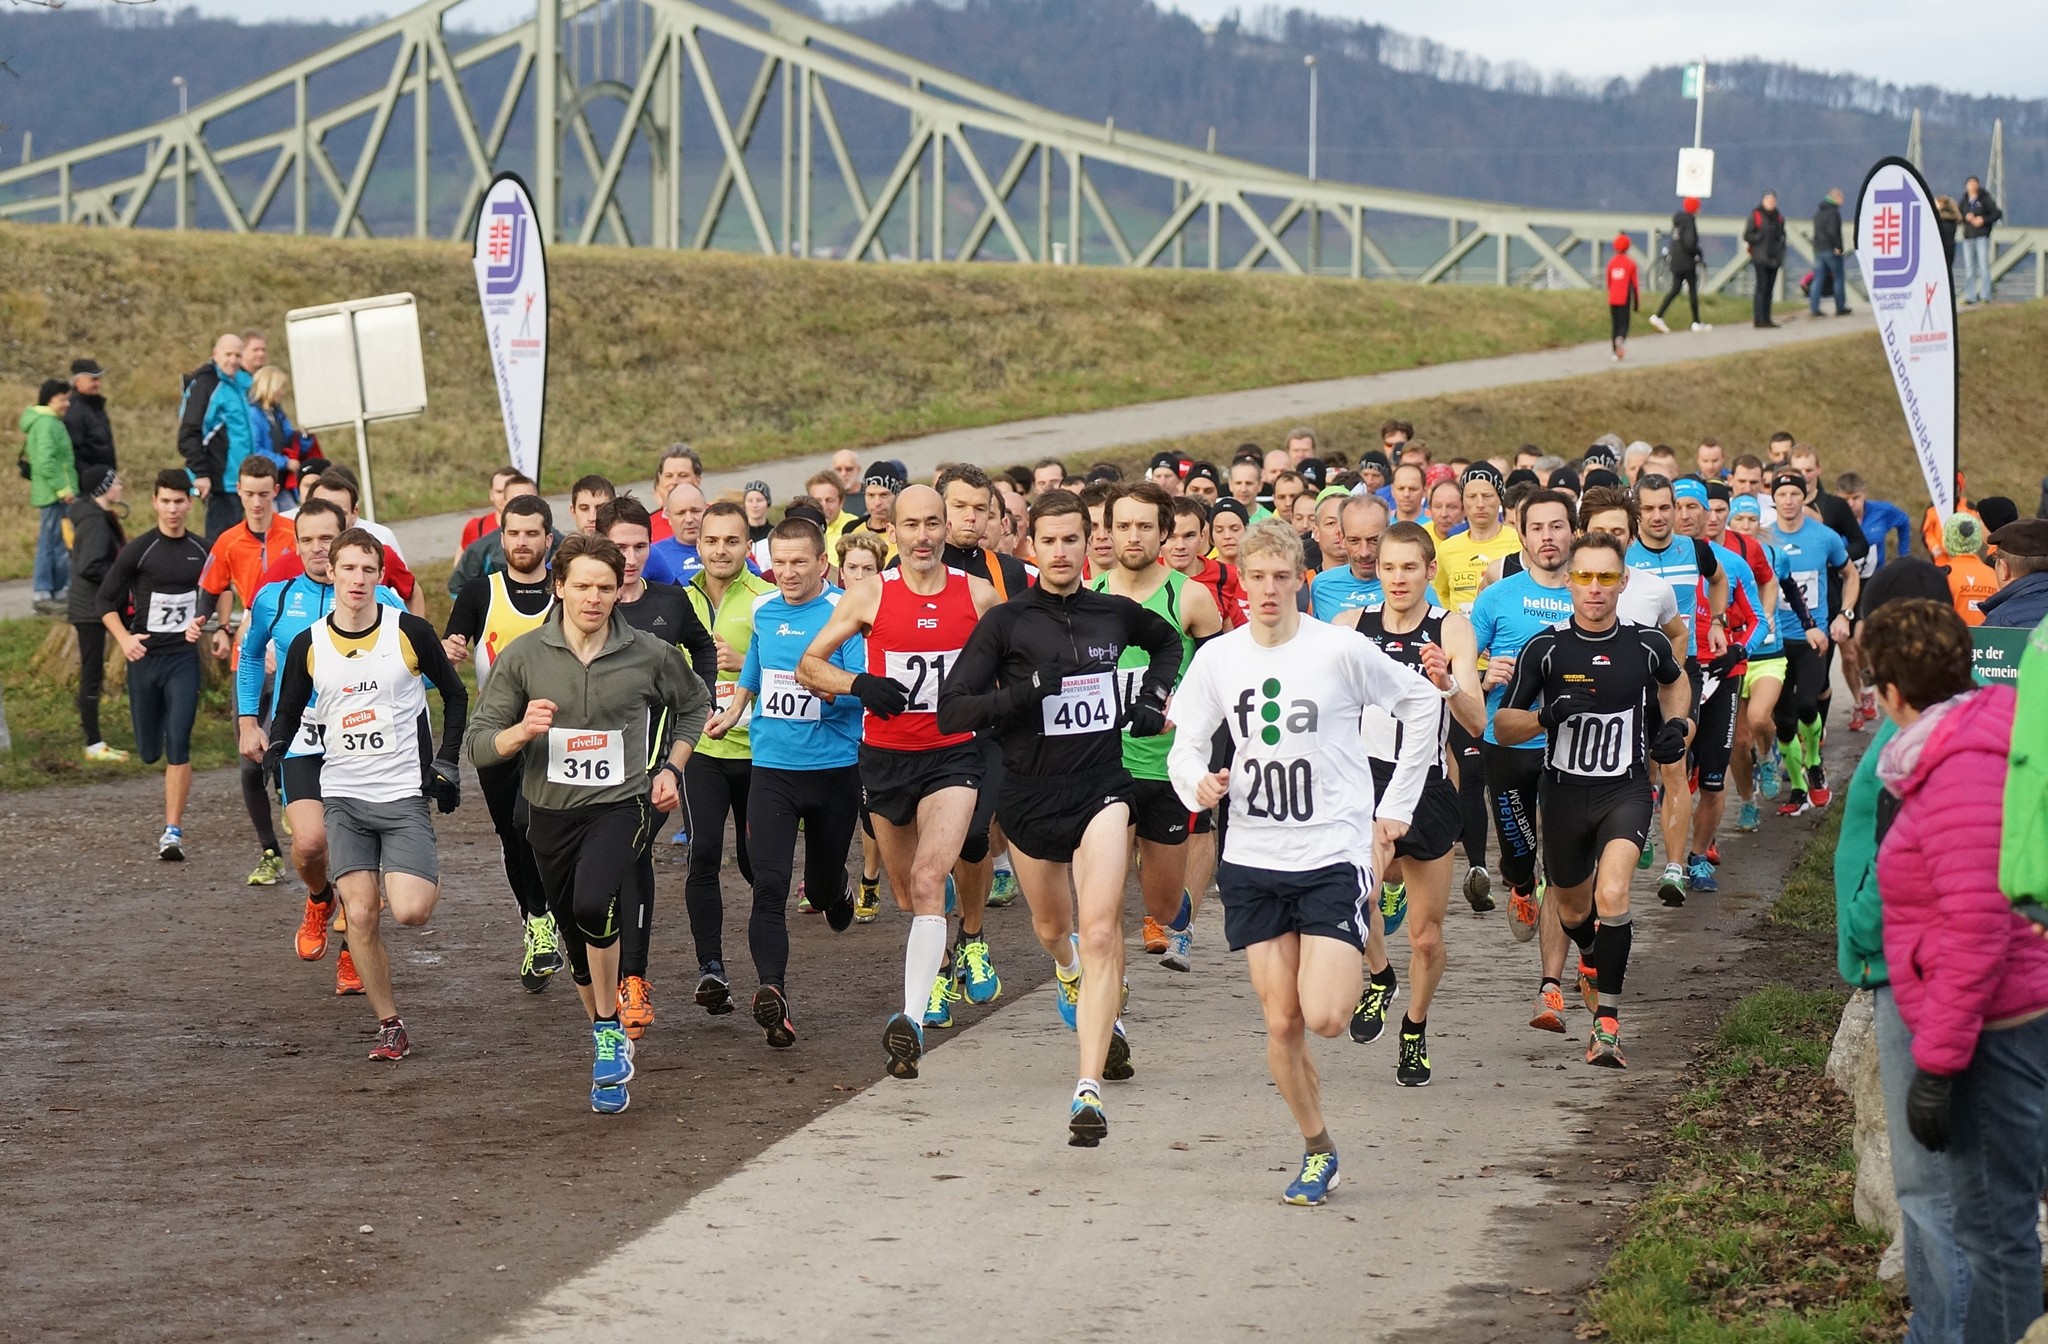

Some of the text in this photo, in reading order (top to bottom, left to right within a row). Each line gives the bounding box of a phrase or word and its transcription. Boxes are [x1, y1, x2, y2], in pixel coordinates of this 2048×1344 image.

[1453, 573, 1475, 582] ULC
[161, 606, 188, 626] 73
[917, 618, 938, 629] PS
[1985, 645, 2004, 660] der
[1974, 663, 2021, 679] gemein
[1063, 677, 1100, 687] ORARLBERGER
[765, 691, 813, 717] 407
[1054, 697, 1110, 730] 404
[345, 710, 373, 727] rivella
[1723, 693, 1737, 749] hellblau.com
[342, 731, 385, 751] 376
[571, 736, 604, 750] rivella
[1567, 715, 1625, 773] 100
[563, 757, 611, 780] 316
[1244, 757, 1314, 822] 200
[1507, 788, 1537, 851] POWERTEAM
